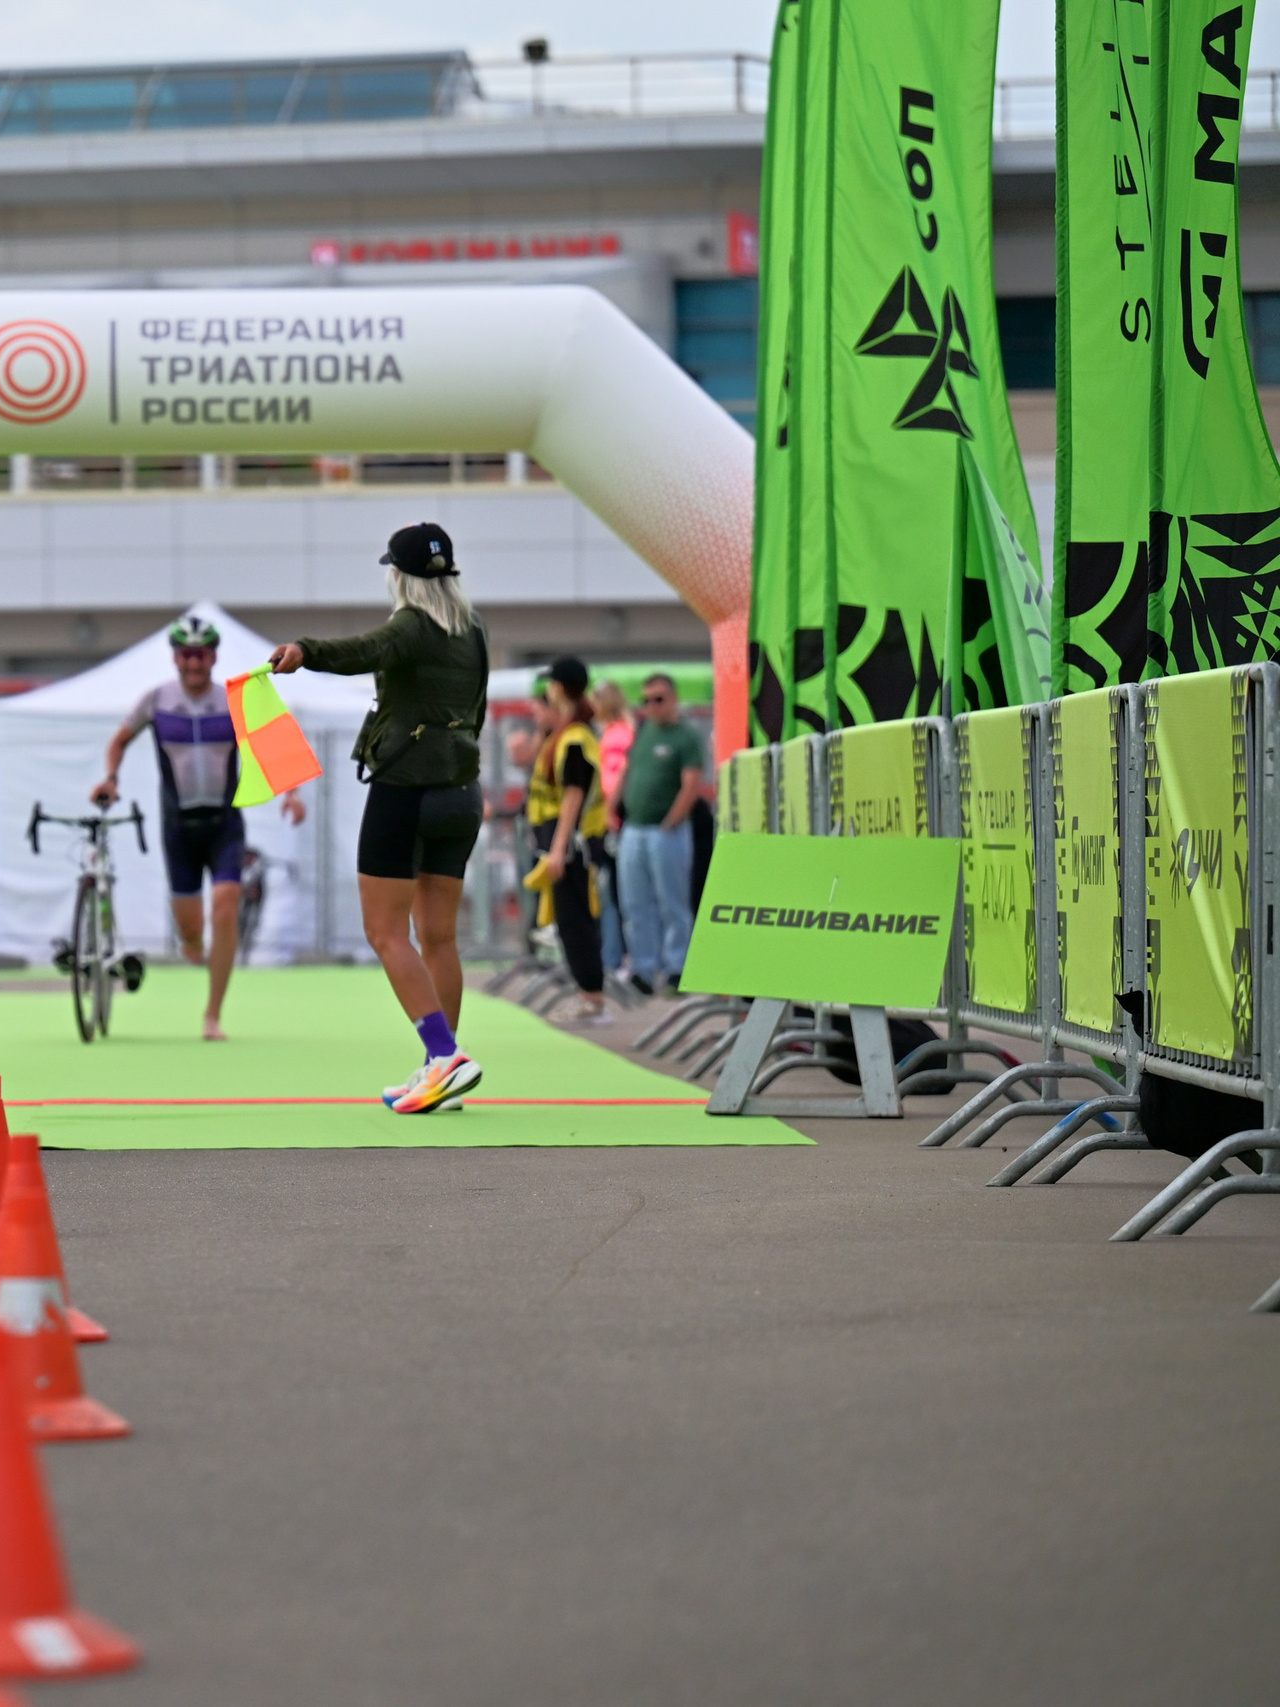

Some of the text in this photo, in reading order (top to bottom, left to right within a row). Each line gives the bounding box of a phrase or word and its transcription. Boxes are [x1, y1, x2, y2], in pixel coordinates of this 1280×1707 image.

[140, 316, 404, 346] ФЕДЕРАЦИЯ
[140, 355, 403, 385] ТРИАТЛОНА
[142, 396, 313, 425] РОССИИ
[854, 796, 901, 836] STELLAR
[709, 904, 940, 935] СПЕШИВАНИЕ
